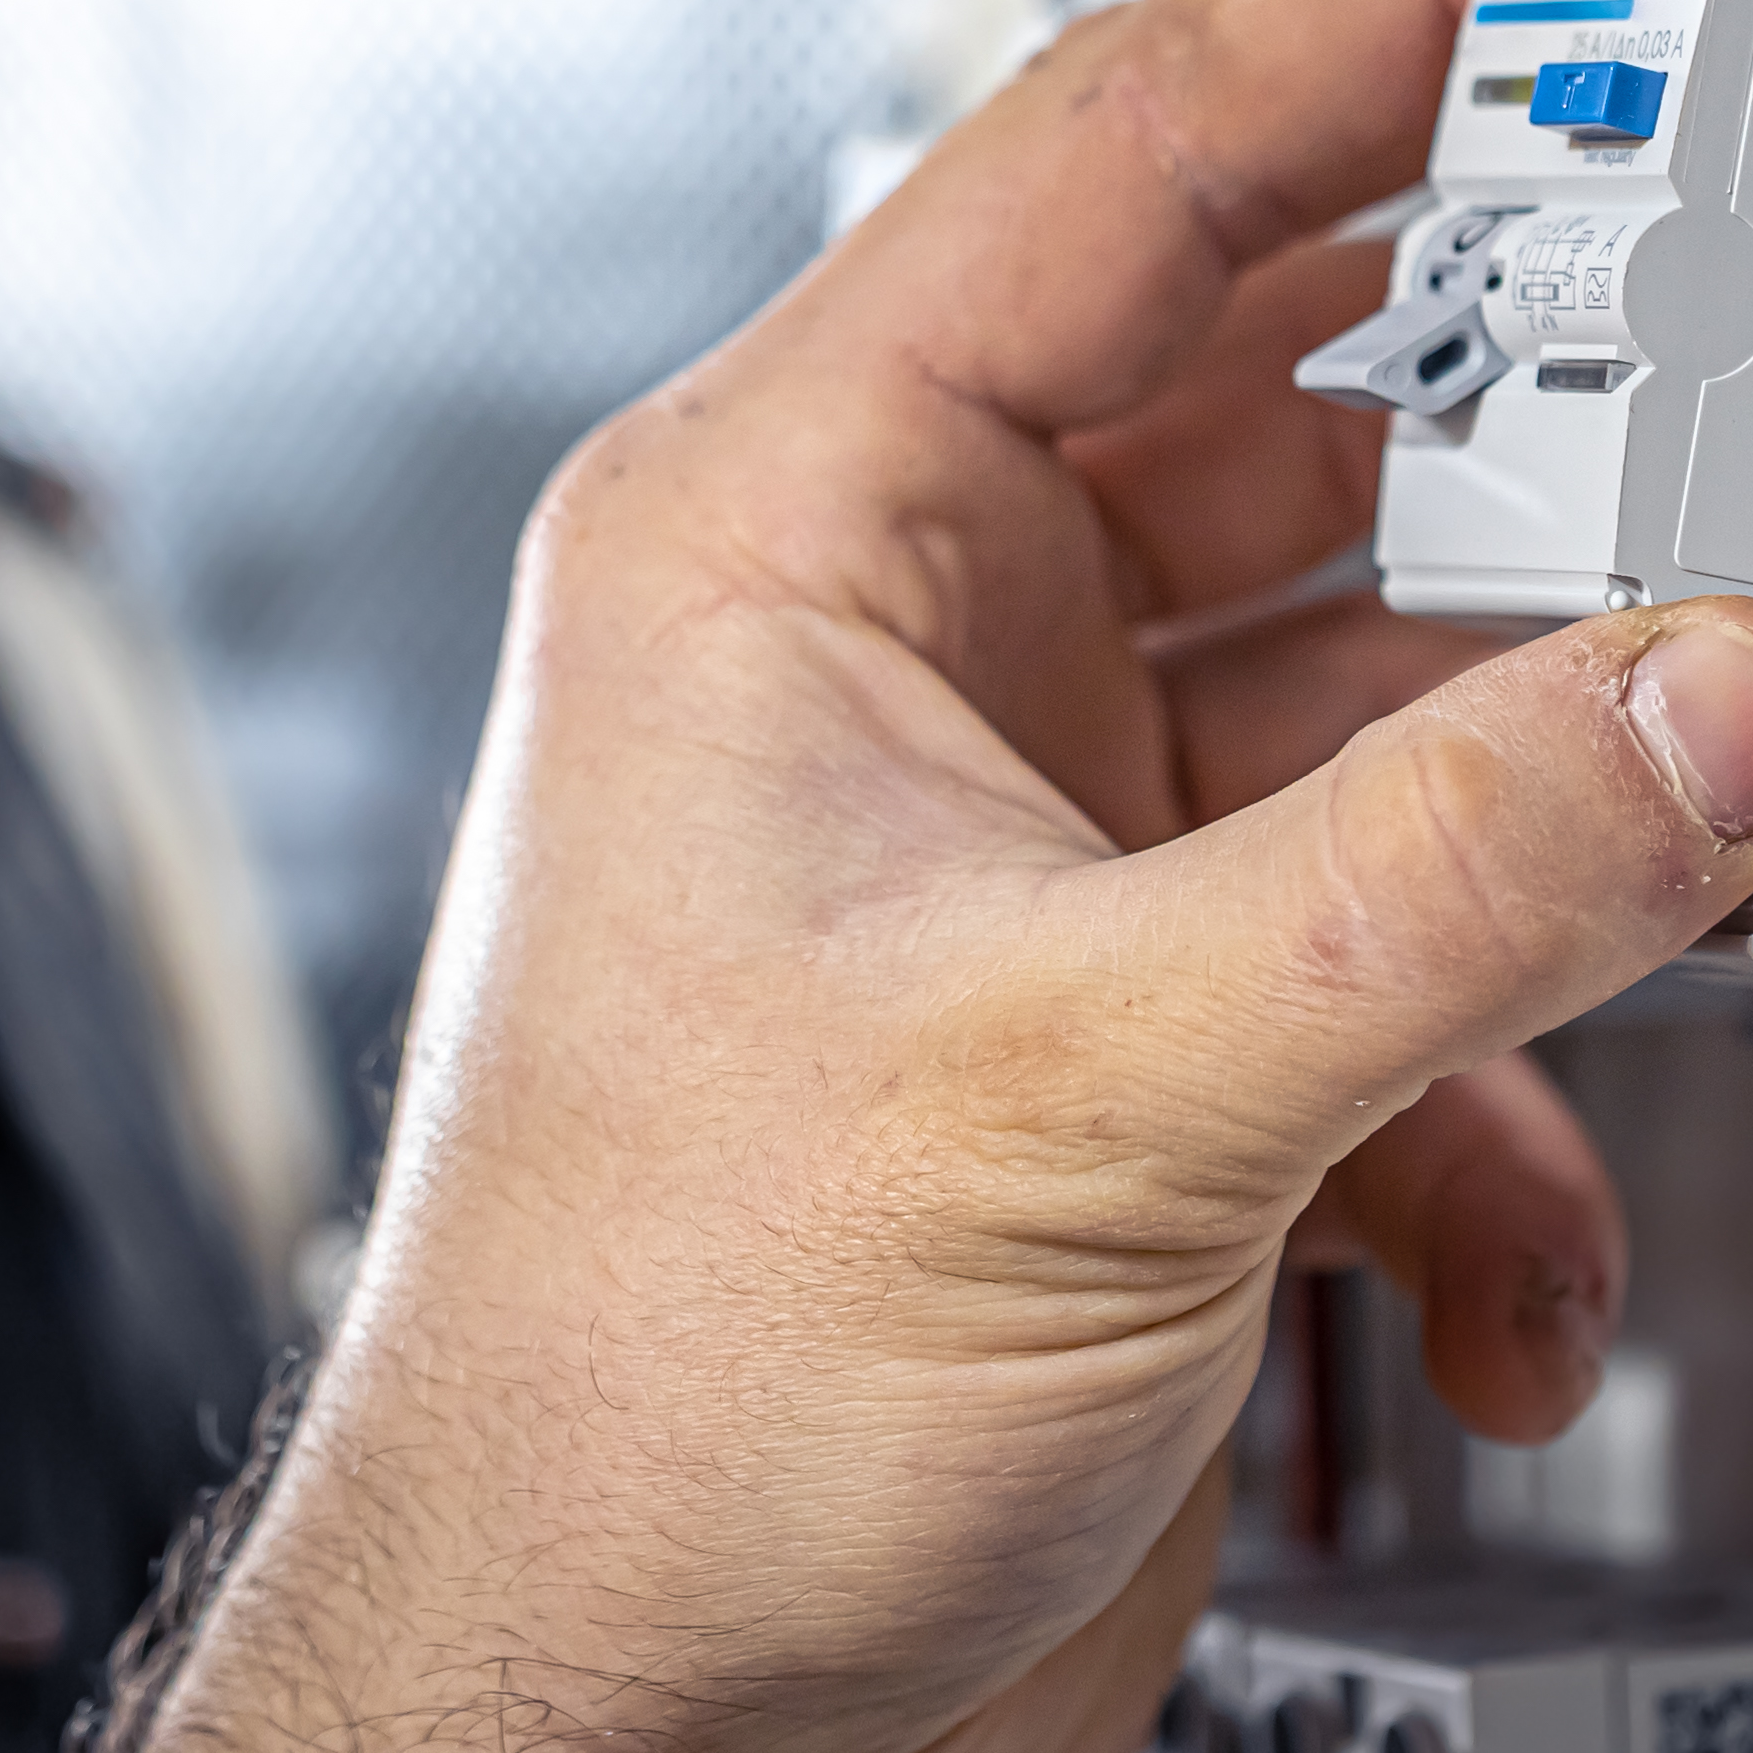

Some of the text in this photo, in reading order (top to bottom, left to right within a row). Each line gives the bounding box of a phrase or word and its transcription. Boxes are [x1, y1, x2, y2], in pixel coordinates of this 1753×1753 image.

[1637, 29, 1671, 63] 0,03
[1670, 28, 1685, 59] A
[1597, 224, 1628, 257] A
